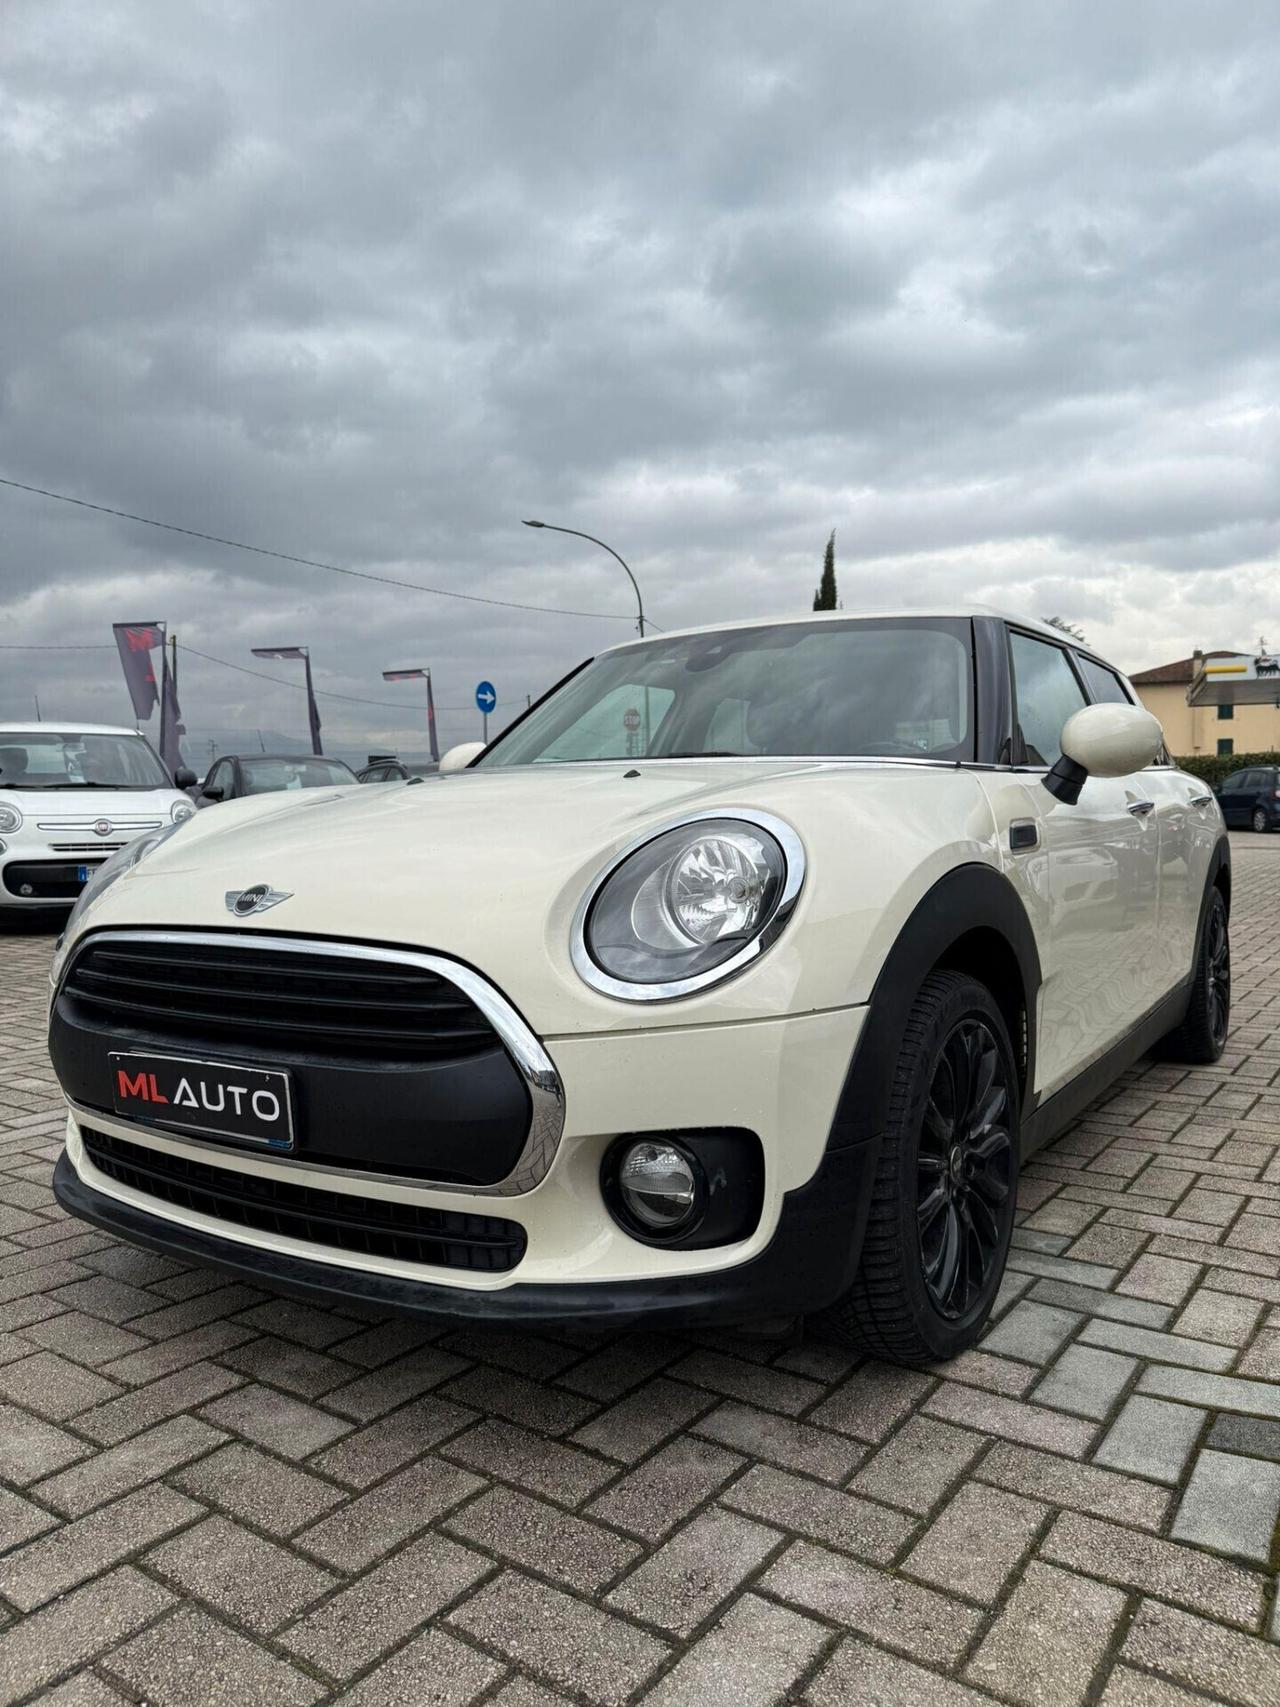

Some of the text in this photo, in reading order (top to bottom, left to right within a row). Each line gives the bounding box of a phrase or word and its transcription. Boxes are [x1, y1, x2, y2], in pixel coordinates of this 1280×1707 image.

[624, 715, 640, 725] STOP
[239, 893, 264, 902] MINI
[117, 1070, 280, 1122] ML AUTO
